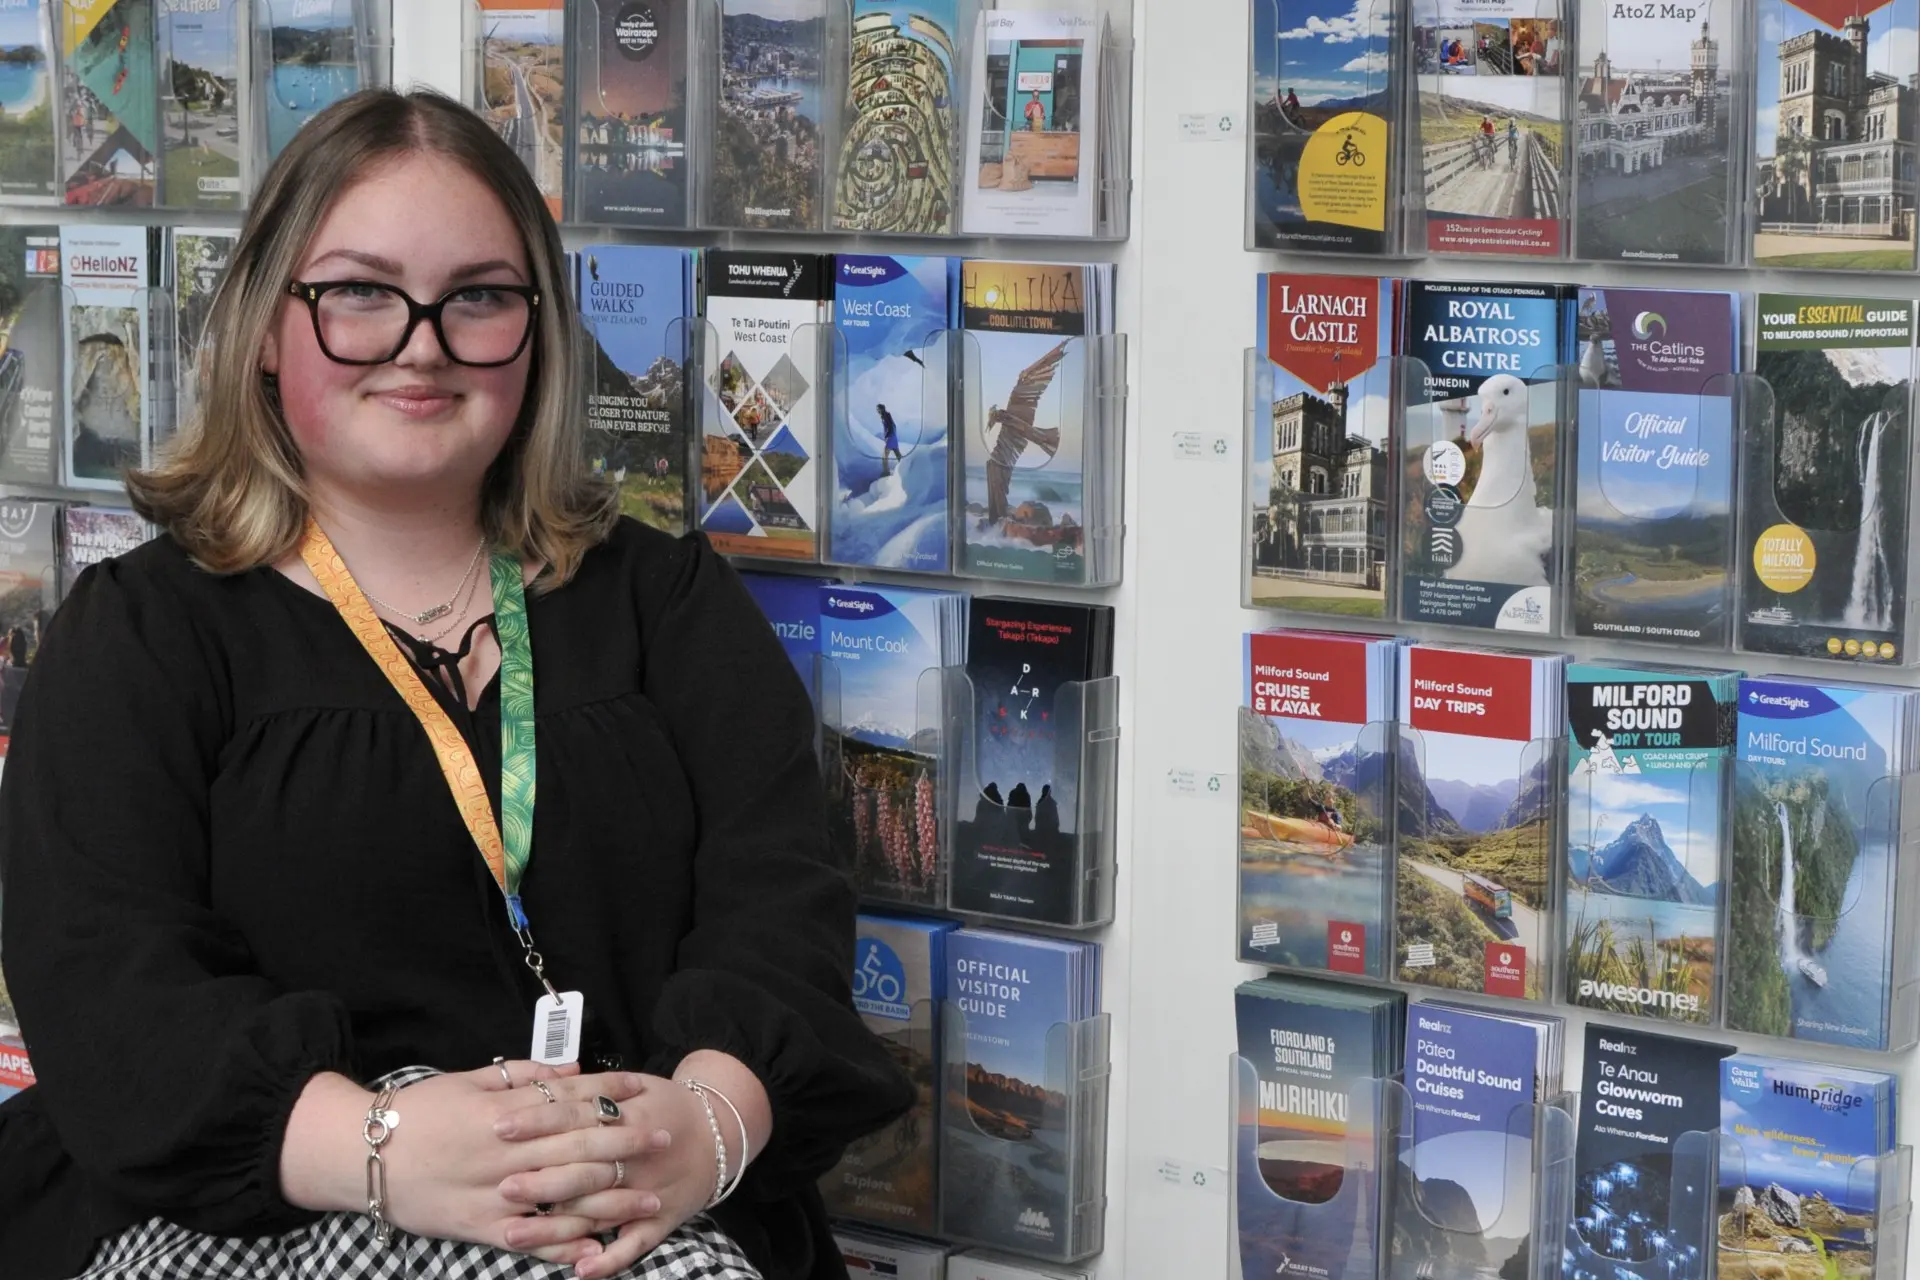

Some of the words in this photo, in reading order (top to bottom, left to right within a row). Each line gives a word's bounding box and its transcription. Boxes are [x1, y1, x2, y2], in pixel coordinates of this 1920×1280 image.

[1613, 4, 1656, 18] AtoZ
[1660, 4, 1696, 22] Map
[616, 27, 658, 38] Wairarapa
[82, 255, 138, 272] HelloNZ
[728, 264, 751, 276] TOHU
[752, 265, 788, 277] WHENUA
[850, 265, 886, 278] GreatSights
[590, 281, 644, 298] GUIDED
[1513, 288, 1545, 296] PENINSULA
[591, 298, 634, 313] WALKS
[842, 298, 873, 316] West
[875, 300, 912, 318] Coast
[1281, 285, 1367, 317] LARNACH
[1448, 300, 1516, 320] ROYAL
[731, 317, 741, 327] Te
[743, 318, 756, 328] Tai
[758, 319, 791, 330] Poutini
[1762, 313, 1797, 325] YOUR
[1798, 305, 1866, 325] ESSENTIAL
[1866, 310, 1908, 322] GUIDE
[734, 331, 757, 342] West
[759, 332, 787, 343] Coast
[1290, 314, 1358, 344] CASTLE
[1424, 324, 1541, 347] ALBATROSS
[1762, 331, 1774, 340] TO
[1775, 329, 1815, 339] MILFORD
[1815, 328, 1849, 338] SOUND
[1855, 327, 1909, 337] PIOPIOTAHI
[1631, 343, 1648, 351] THE
[1649, 340, 1705, 356] Catlins
[1441, 350, 1522, 371] CENTRE
[1423, 377, 1470, 389] DUNEDIN
[588, 394, 630, 407] BRINGING
[629, 397, 648, 408] YOU
[588, 407, 620, 418] CLOSER
[621, 408, 634, 419] TO
[635, 410, 670, 421] NATURE
[589, 419, 613, 429] THAN
[614, 420, 636, 431] EVER
[637, 422, 671, 433] BEFORE
[1625, 411, 1688, 439] Official
[1602, 440, 1656, 463] Visitor
[1656, 444, 1710, 470] Guide
[1762, 538, 1804, 552] TOTALLY
[1432, 554, 1453, 563] tiaki
[1762, 553, 1804, 567] MILFORD
[1420, 580, 1436, 590] Royal
[1436, 582, 1464, 590] Albatross
[1464, 582, 1485, 592] Centre
[836, 599, 875, 613] GreatSights
[769, 620, 815, 640] nzie
[1592, 622, 1641, 634] SOUTHLAND
[1645, 626, 1673, 636] SOUTH
[1673, 629, 1701, 638] OTAGO
[831, 631, 873, 650] Mount
[875, 635, 909, 654] Cook
[1254, 664, 1294, 678] Milford
[1295, 668, 1330, 681] Sound
[1254, 681, 1311, 700] CRUISE
[1414, 678, 1455, 693] Milford
[1456, 683, 1493, 697] Sound
[1592, 684, 1692, 707] MILFORD
[1255, 697, 1266, 711] &
[1270, 698, 1322, 717] KAYAK
[1414, 695, 1442, 711] DAY
[1445, 699, 1486, 716] TRIPS
[1759, 694, 1810, 711] GreatSights
[1606, 707, 1683, 730] SOUND
[1612, 732, 1641, 746] DAY
[1644, 732, 1682, 747] TOUR
[1748, 731, 1807, 755] Milford
[1810, 737, 1867, 761] Sound
[1642, 752, 1667, 760] COACH
[1668, 752, 1684, 760] AND
[1747, 754, 1762, 762] DAY
[1763, 755, 1786, 765] TOURS
[956, 958, 1031, 984] OFFICIAL
[1490, 965, 1520, 975] southern
[957, 977, 1021, 1002] VISITOR
[1579, 979, 1690, 1010] awesome
[958, 997, 1007, 1018] GUIDE
[1419, 1017, 1452, 1034] Realnz
[1270, 1029, 1326, 1052] FIORDLAND
[1327, 1037, 1335, 1054] &
[1417, 1039, 1456, 1060] Pātea
[1599, 1038, 1637, 1055] Realnz
[1274, 1046, 1332, 1071] SOUTHLAND
[1416, 1058, 1475, 1083] Doubtful
[1477, 1069, 1522, 1092] Sound
[1598, 1060, 1615, 1077] Te
[1617, 1064, 1658, 1084] Anau
[1731, 1066, 1758, 1079] Great
[1415, 1077, 1464, 1101] Cruises
[1731, 1076, 1760, 1089] Walks
[1260, 1080, 1348, 1122] MURIHIKU
[1597, 1080, 1683, 1108] Glowworm
[1773, 1079, 1863, 1109] Humpridge
[1595, 1099, 1643, 1121] Caves
[1606, 1126, 1635, 1138] Whenua
[1635, 1131, 1669, 1144] Fiordland
[1792, 1145, 1819, 1158] fewer
